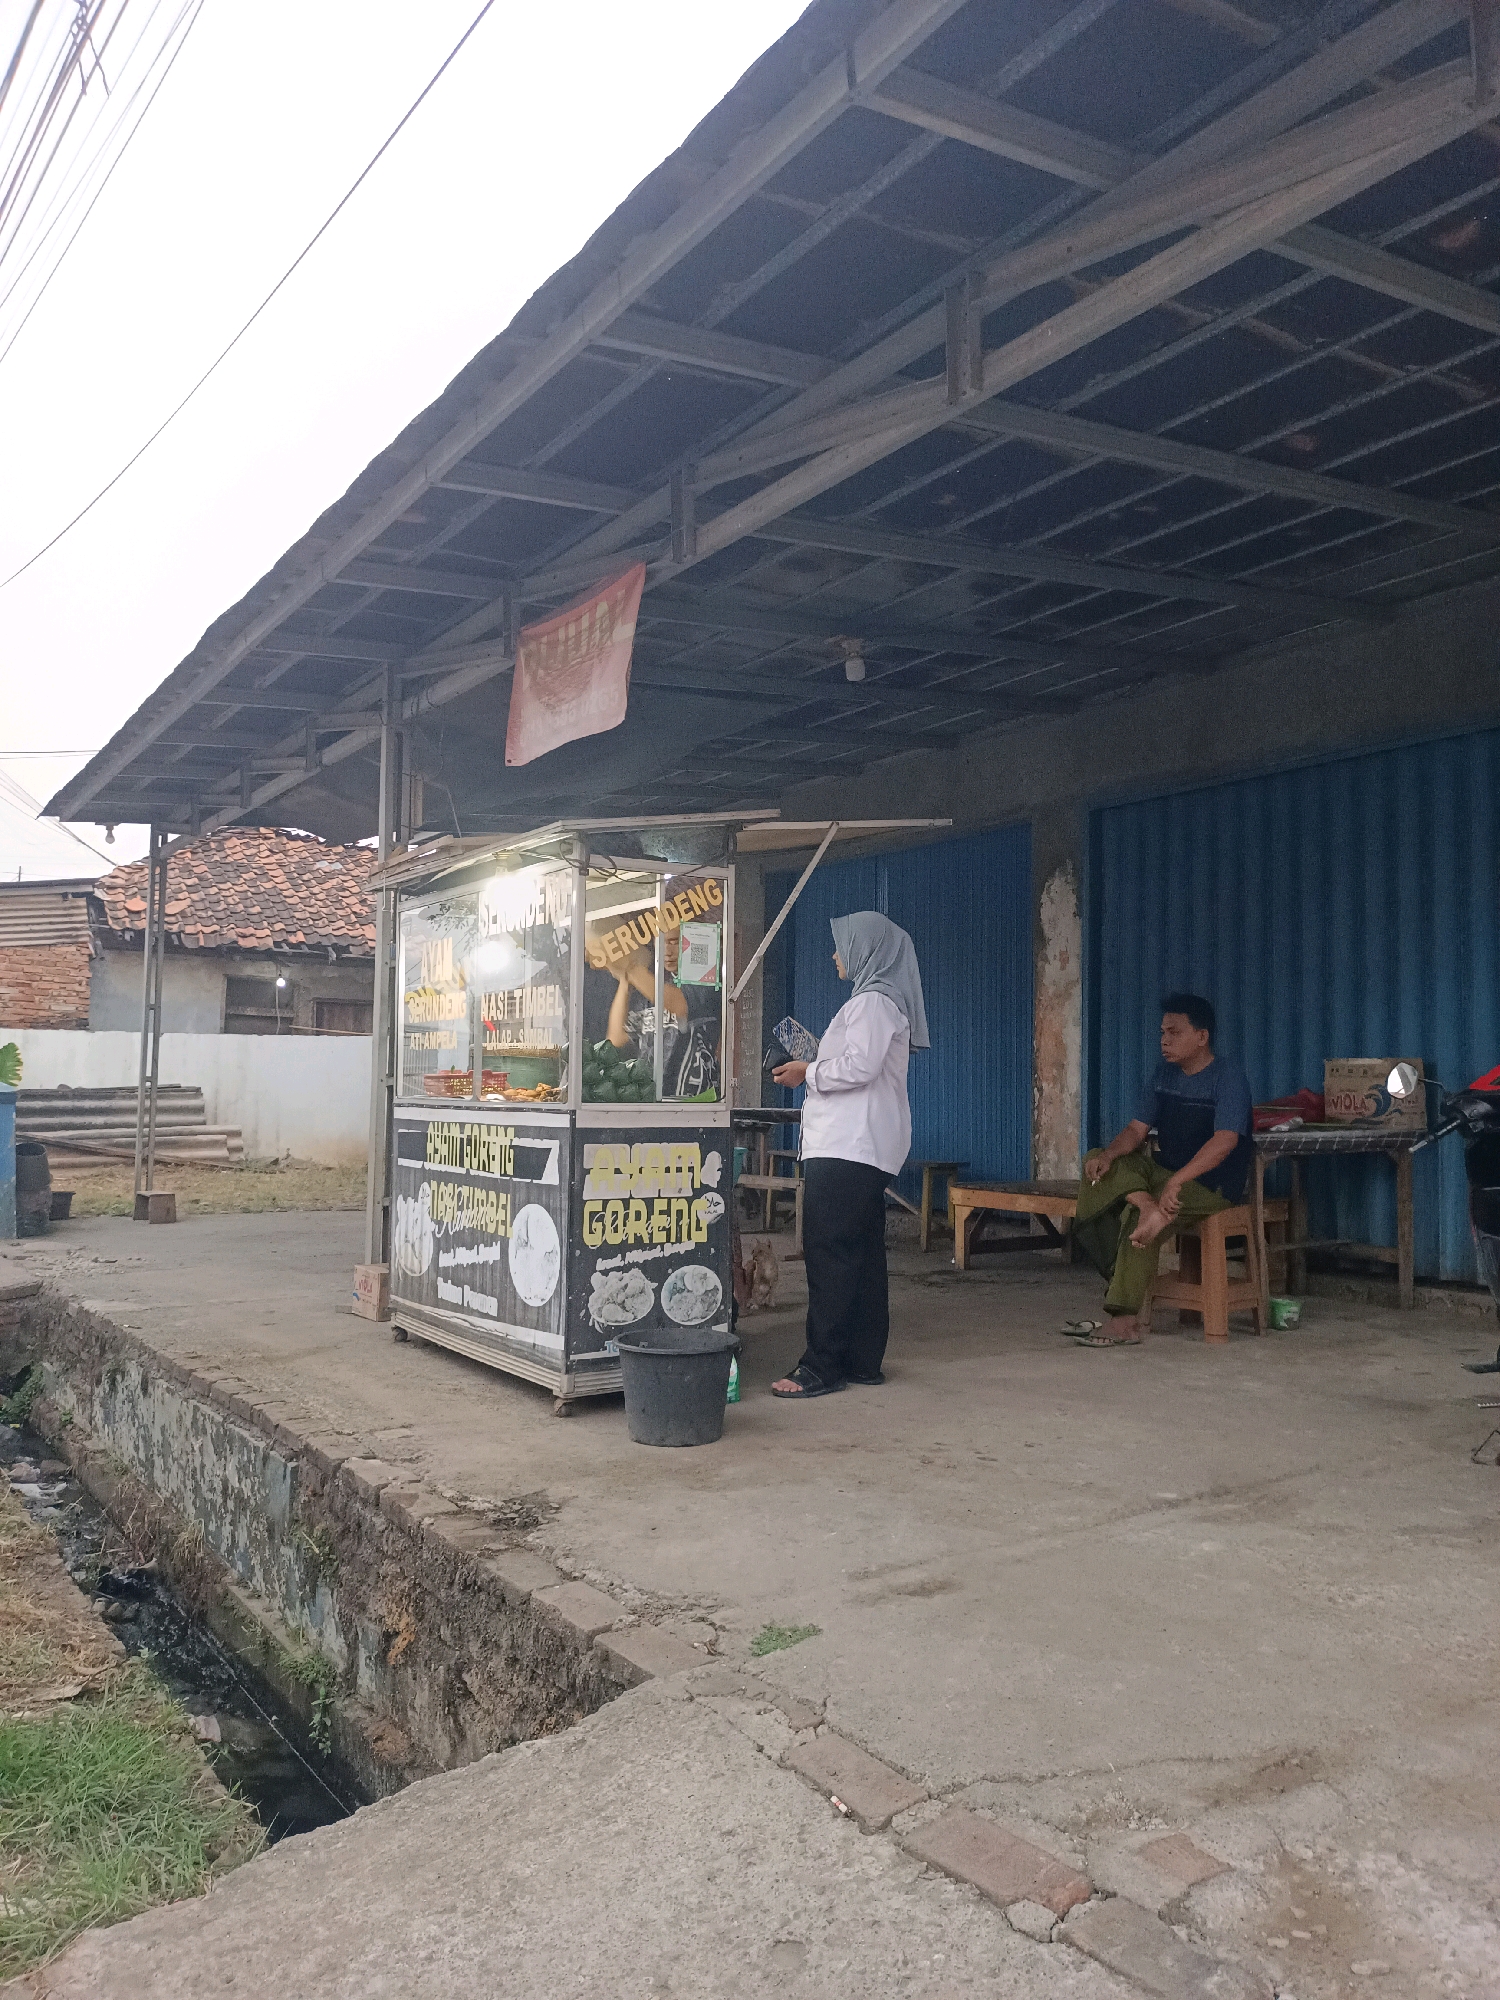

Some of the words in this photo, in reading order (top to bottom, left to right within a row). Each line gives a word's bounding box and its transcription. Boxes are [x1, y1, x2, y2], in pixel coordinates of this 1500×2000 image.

[587, 879, 723, 967] SERUNDENG
[420, 937, 453, 985] AYAM
[481, 990, 508, 1021] NASI
[513, 985, 562, 1018] TIMBEL
[427, 1122, 460, 1167] AYAM
[464, 1124, 514, 1175] GORENG
[590, 1146, 702, 1191] AYAM
[462, 1185, 514, 1238] TIMBEL
[583, 1198, 708, 1246] GORENG
